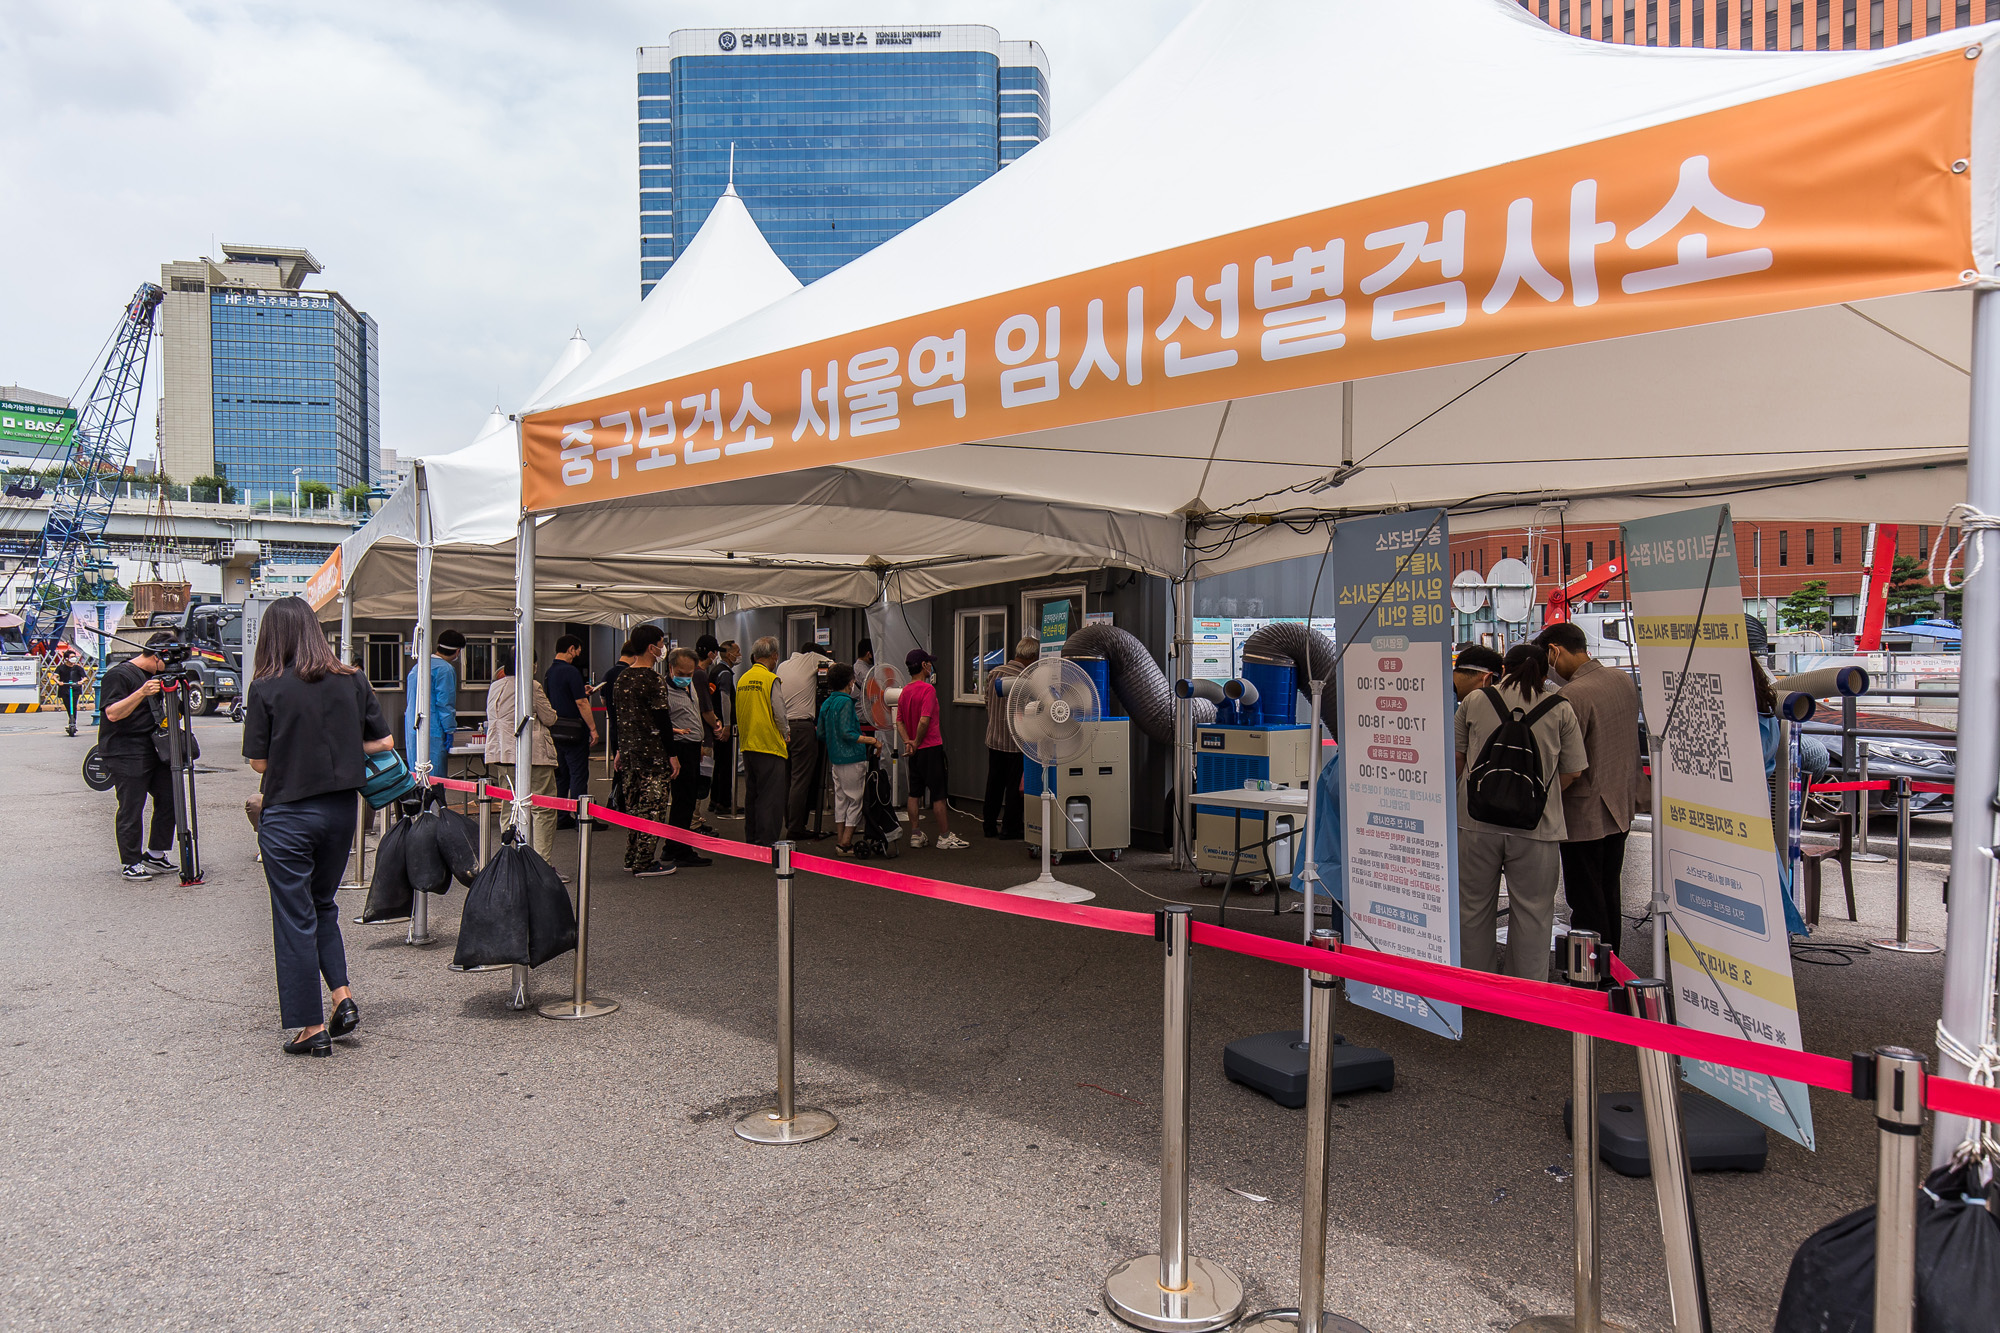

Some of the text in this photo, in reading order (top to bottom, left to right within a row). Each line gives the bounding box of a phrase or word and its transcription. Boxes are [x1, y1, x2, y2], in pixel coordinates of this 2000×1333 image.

[741, 32, 868, 48] 연세대학교 세브란스
[902, 29, 943, 38] UNIVERSITY
[225, 294, 330, 308] HF 한국주택금융공사
[559, 154, 1773, 486] 중구보건소 서울역 임시선별검사소
[24, 419, 65, 434] BASF
